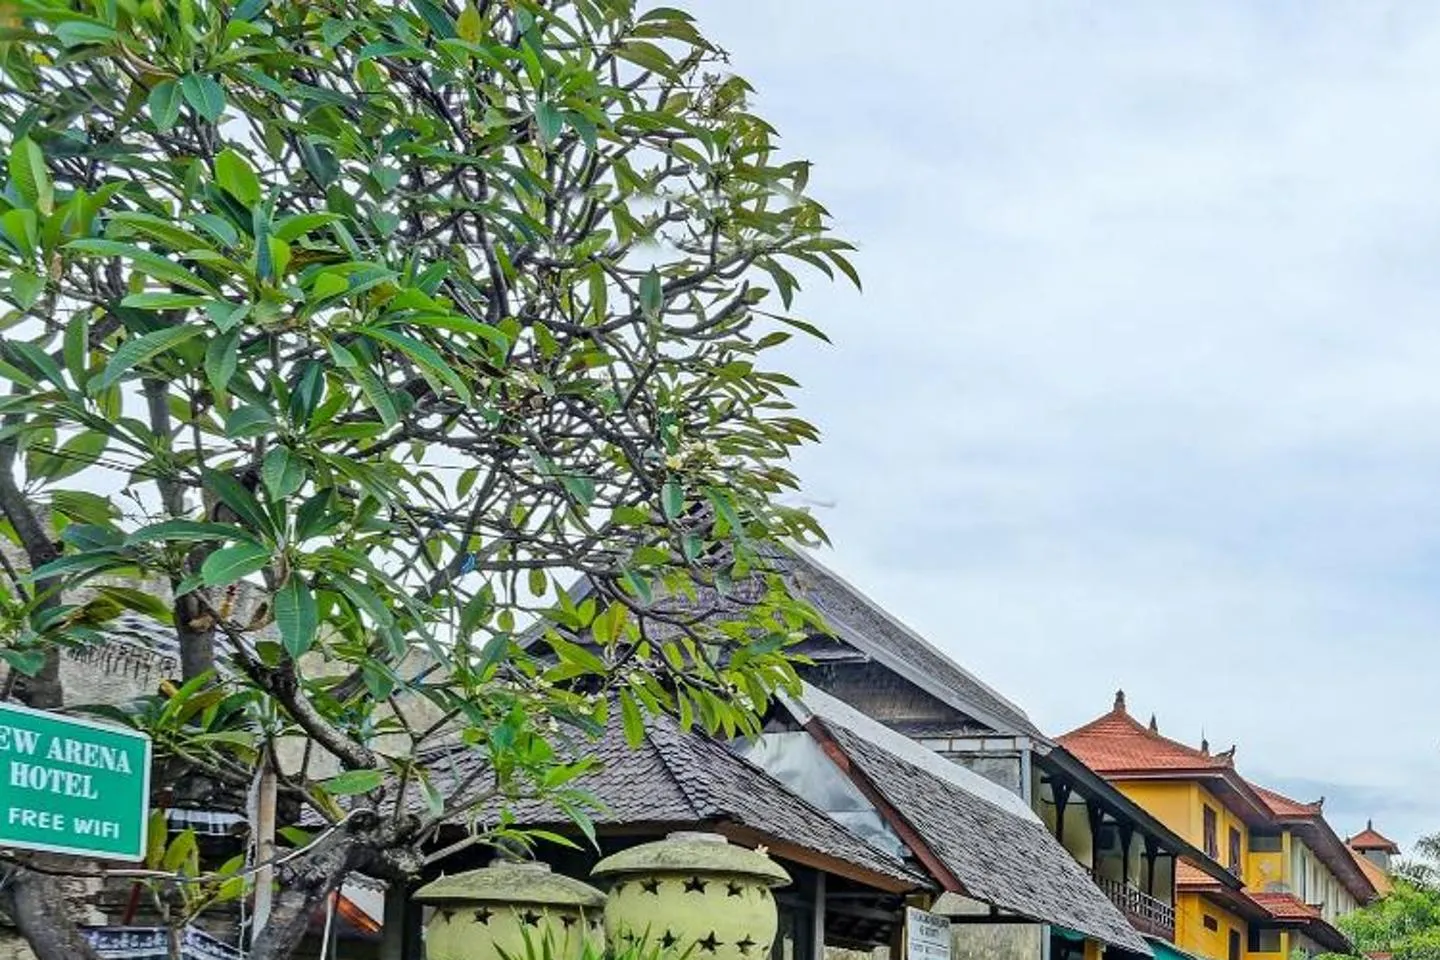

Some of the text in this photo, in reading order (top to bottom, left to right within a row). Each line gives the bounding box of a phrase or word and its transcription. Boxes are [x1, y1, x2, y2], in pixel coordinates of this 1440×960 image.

[0, 725, 132, 774] EW ARENA
[10, 761, 98, 799] HOTEL
[9, 807, 120, 839] FREE WIFI
